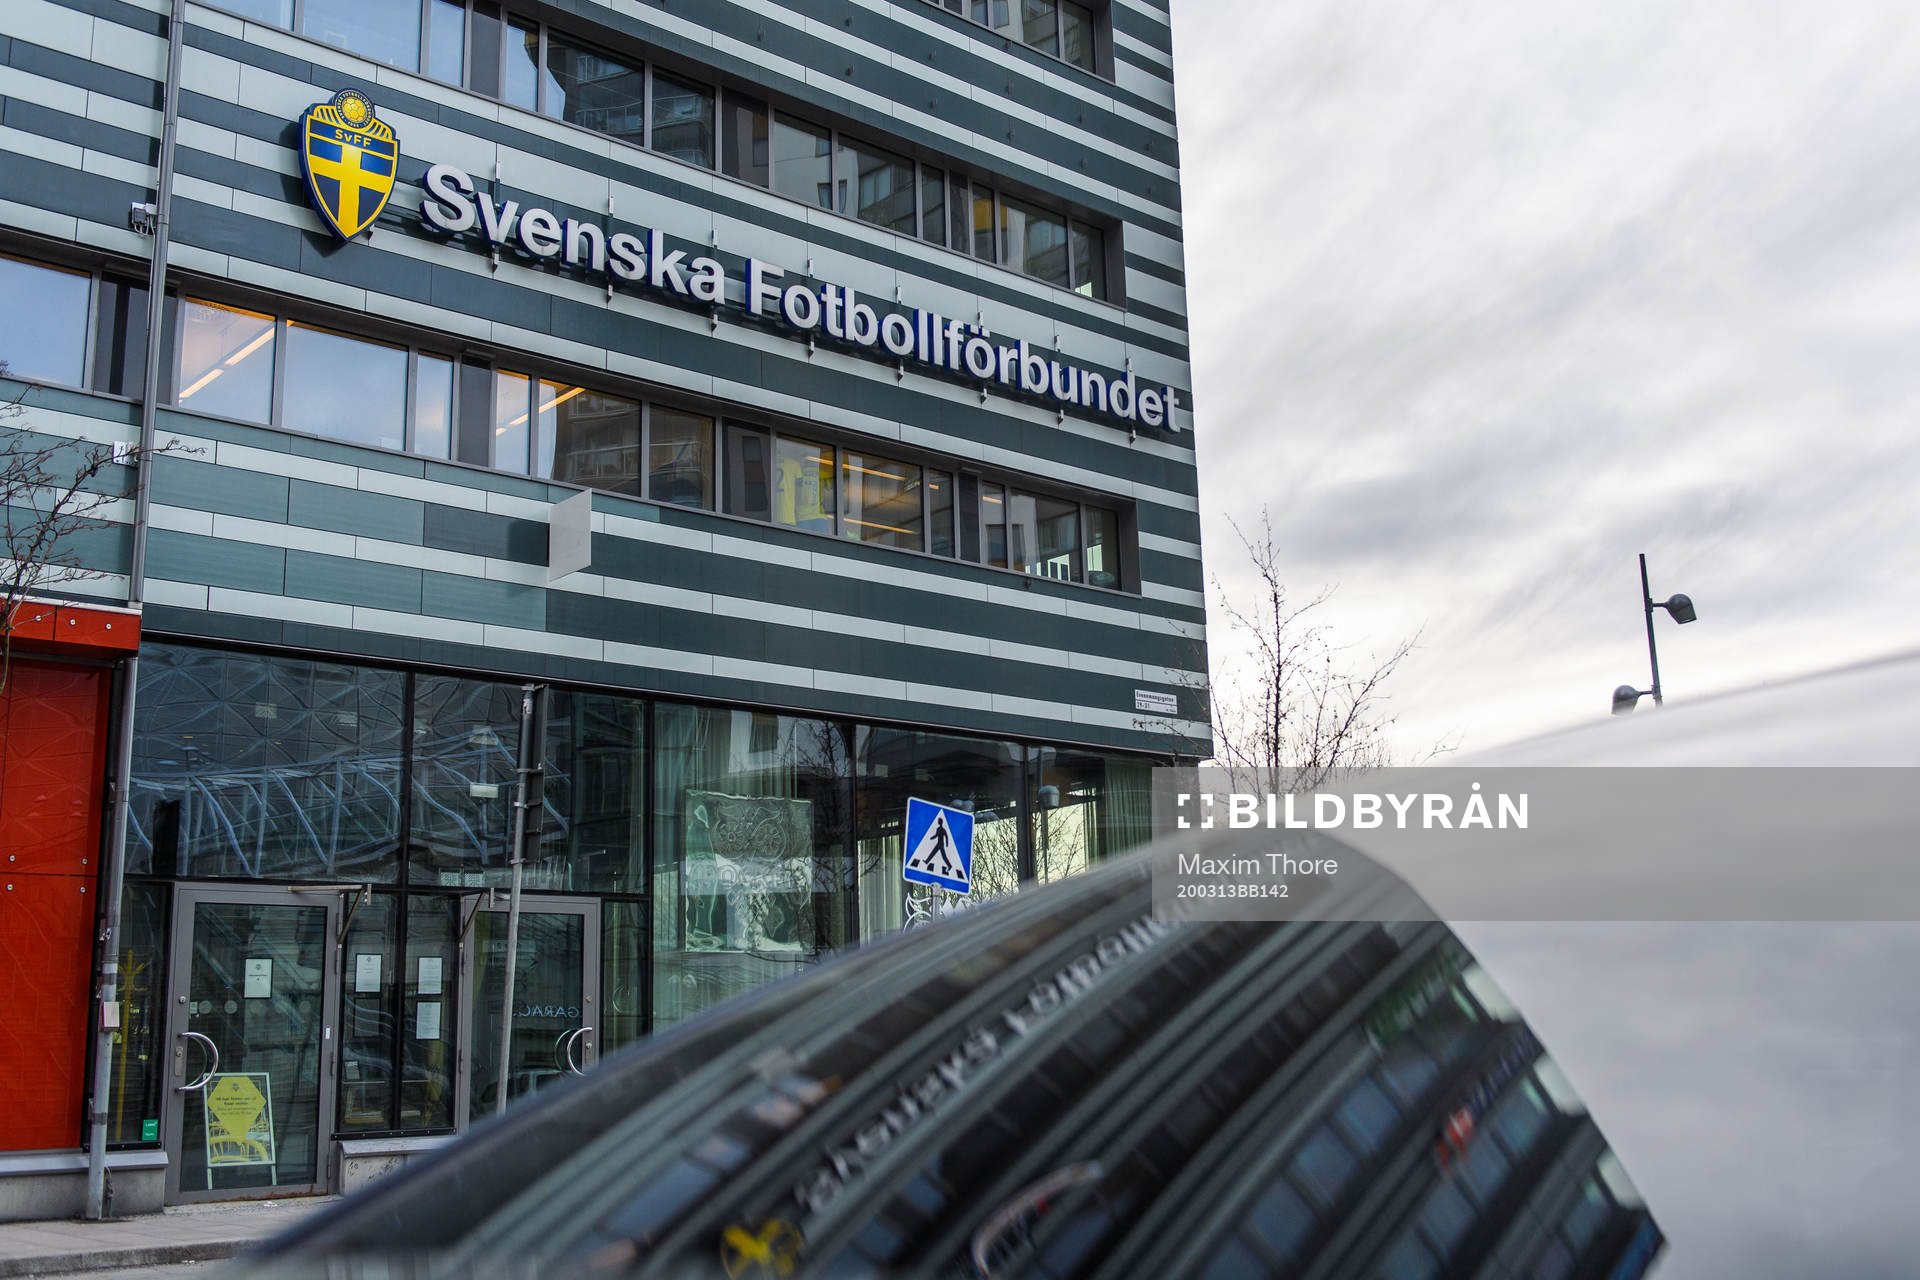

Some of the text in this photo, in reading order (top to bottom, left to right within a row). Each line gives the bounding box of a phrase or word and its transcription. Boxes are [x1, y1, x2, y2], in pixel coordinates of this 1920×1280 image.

[335, 129, 372, 147] SvFF
[420, 164, 1181, 433] Svenska Fotbollförbundet
